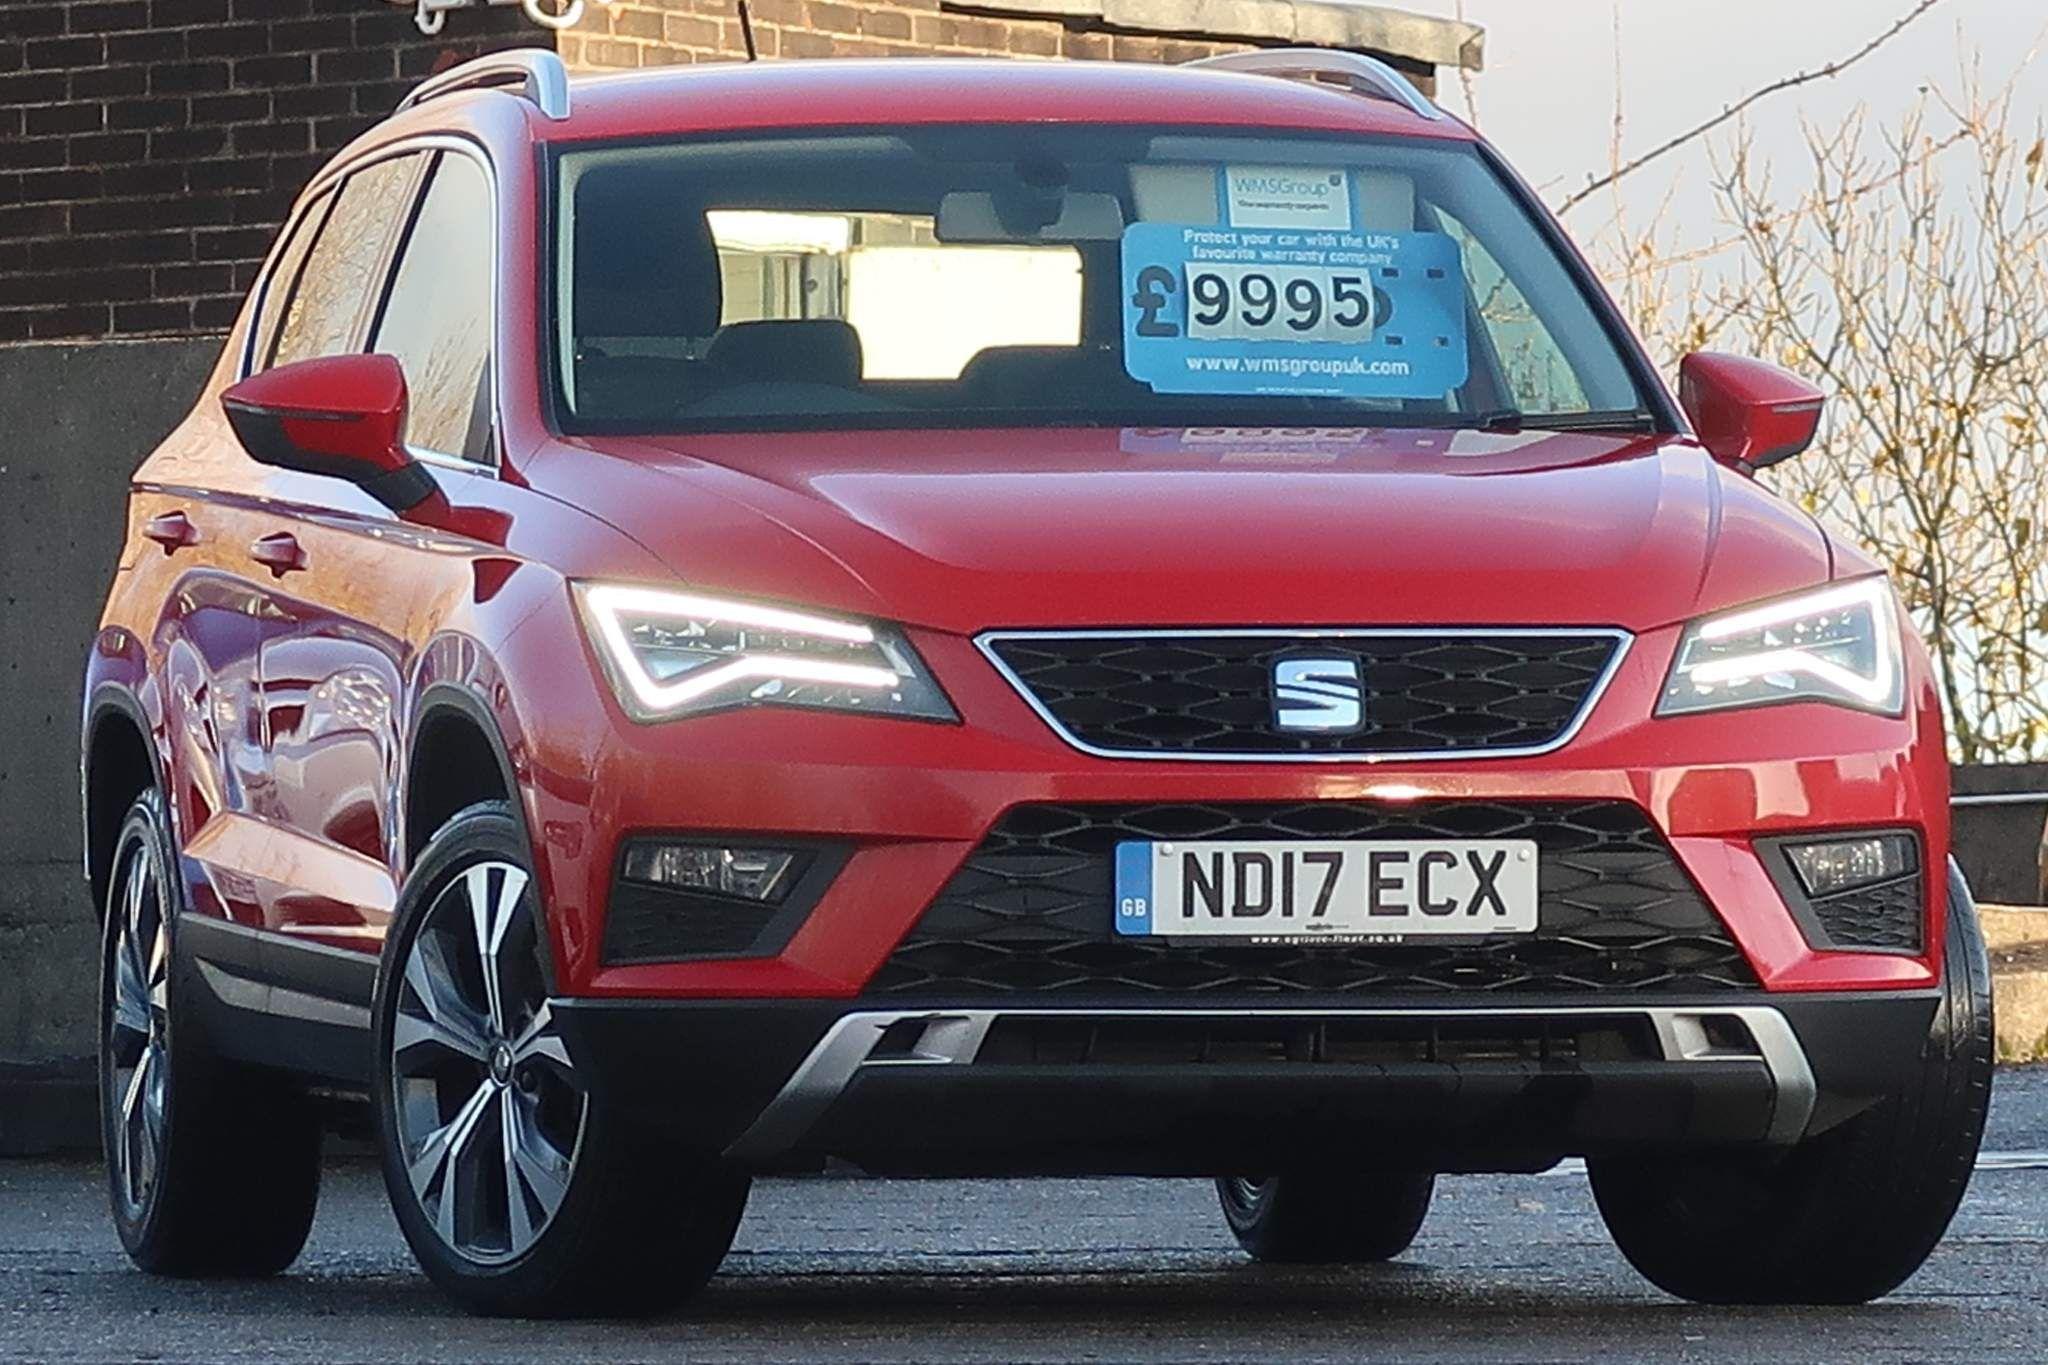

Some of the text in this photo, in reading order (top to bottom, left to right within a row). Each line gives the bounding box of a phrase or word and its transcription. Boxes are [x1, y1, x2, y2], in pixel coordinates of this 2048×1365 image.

[1235, 177, 1329, 198] WMSGroup
[1183, 228, 1400, 250] Protect your car with the UK's
[1192, 245, 1393, 266] favourite warranty company
[1186, 355, 1410, 378] www.wmsgroupuk.com
[1182, 849, 1508, 918] ND17 ECX
[1121, 898, 1147, 917] GB
